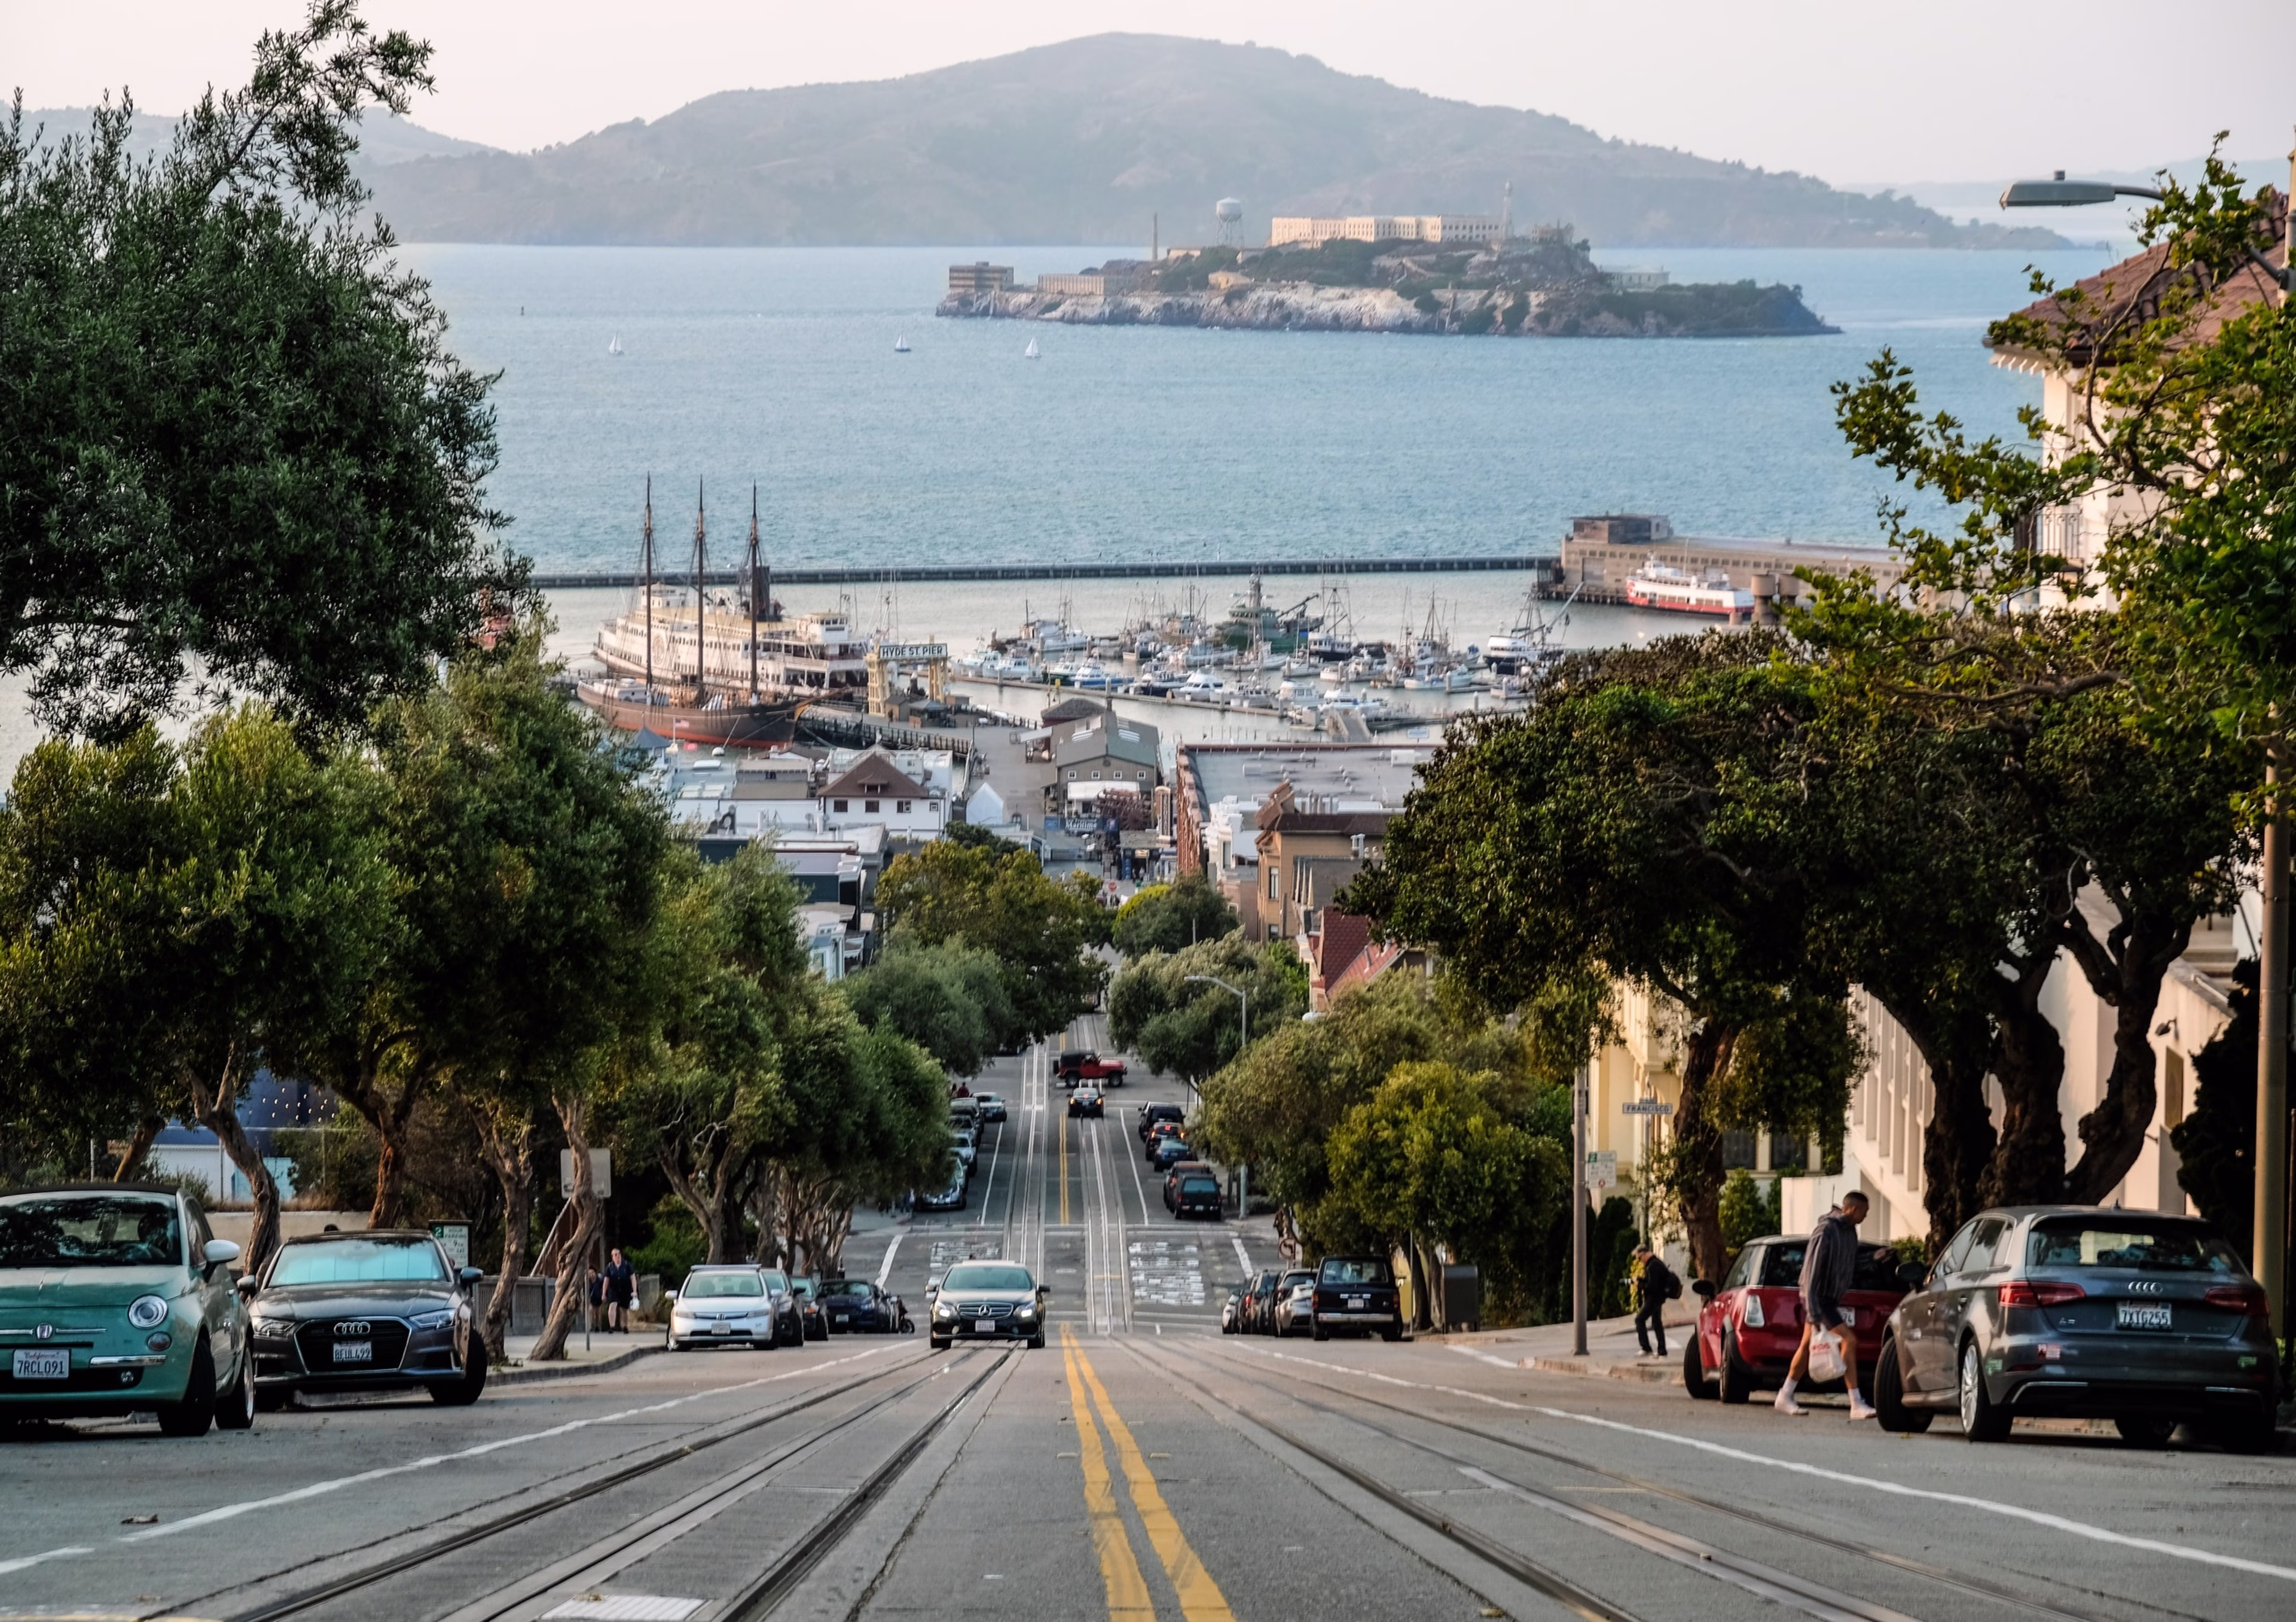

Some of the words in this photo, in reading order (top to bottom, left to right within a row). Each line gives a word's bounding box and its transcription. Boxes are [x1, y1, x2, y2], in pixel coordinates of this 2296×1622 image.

[883, 647, 906, 657] HYDE
[923, 646, 942, 655] PIER
[1065, 821, 1097, 830] Maritime
[435, 1227, 442, 1236] 2
[17, 1360, 65, 1374] 7RCL091
